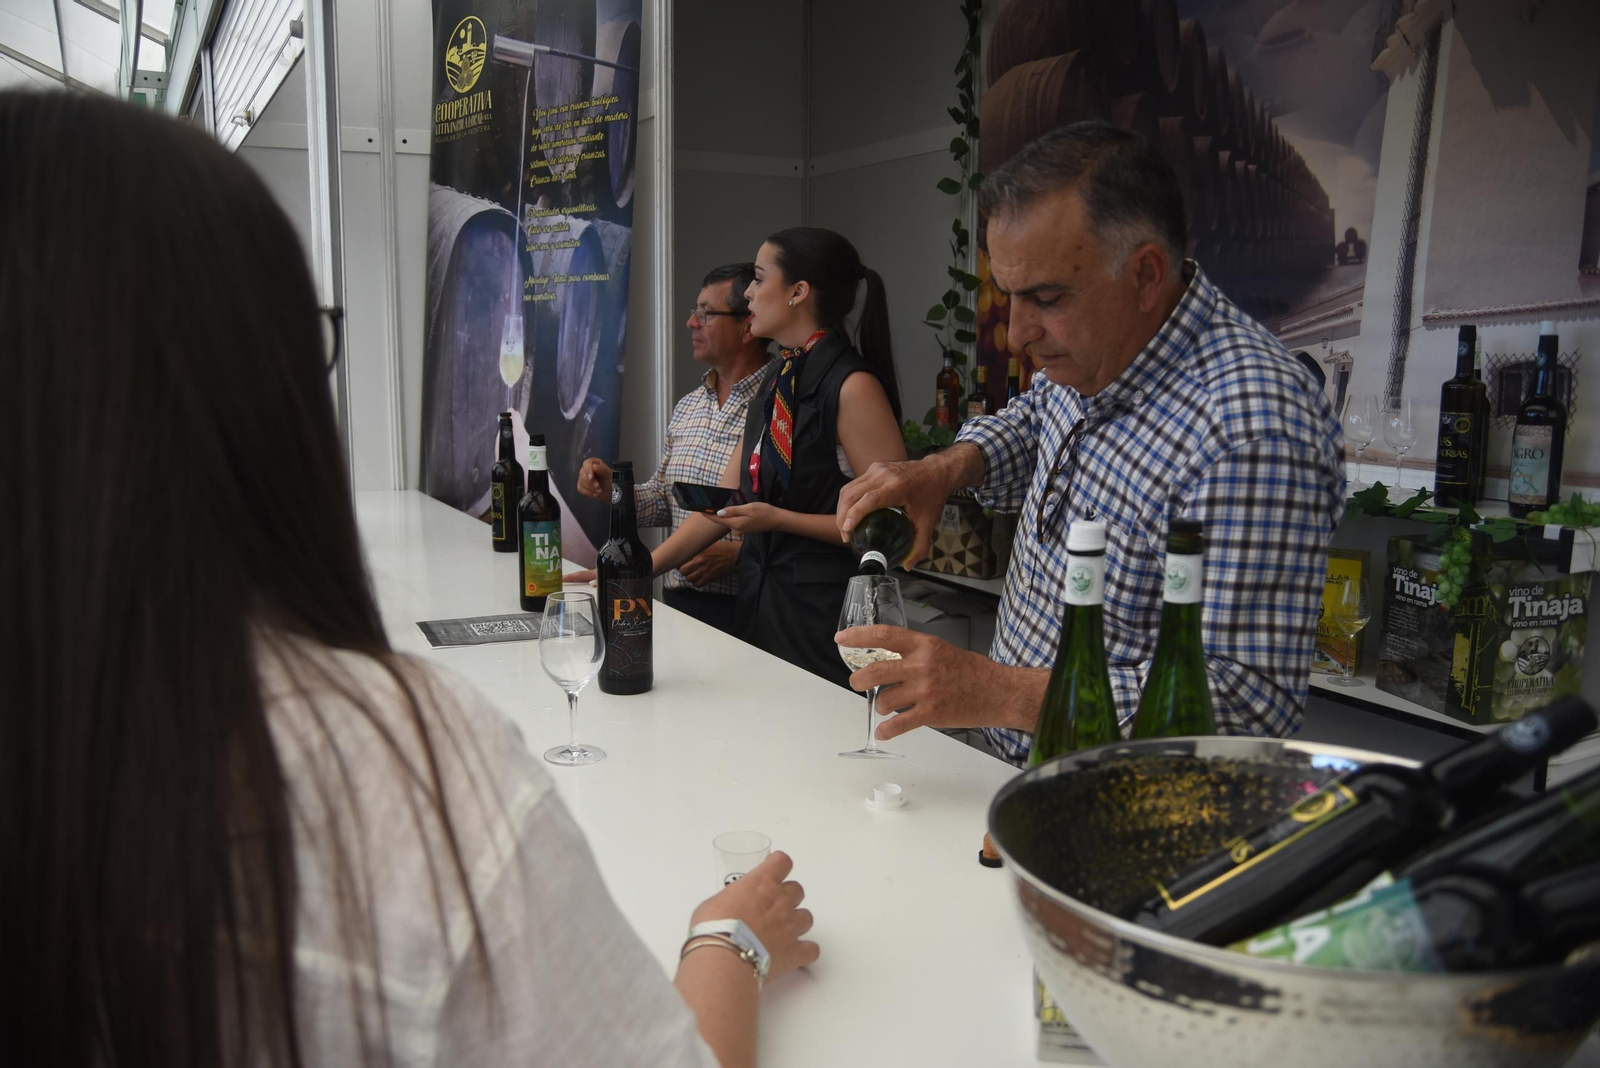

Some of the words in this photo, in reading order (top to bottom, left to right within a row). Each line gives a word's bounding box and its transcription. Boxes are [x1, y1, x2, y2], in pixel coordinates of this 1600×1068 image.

[435, 90, 492, 123] COOPERATIVA
[604, 111, 629, 122] madera
[531, 533, 549, 546] TI
[535, 546, 560, 560] NA
[1393, 565, 1408, 576] vino
[1408, 569, 1418, 578] de
[1392, 573, 1446, 606] Tinaj
[1509, 586, 1530, 597] vino
[1532, 585, 1544, 595] de
[1395, 594, 1407, 602] vino
[1414, 598, 1428, 608] rama
[1508, 593, 1584, 622] Tinaja
[1512, 620, 1528, 628] vino
[1539, 618, 1558, 626] rama
[1507, 676, 1554, 690] COOPERATIVA
